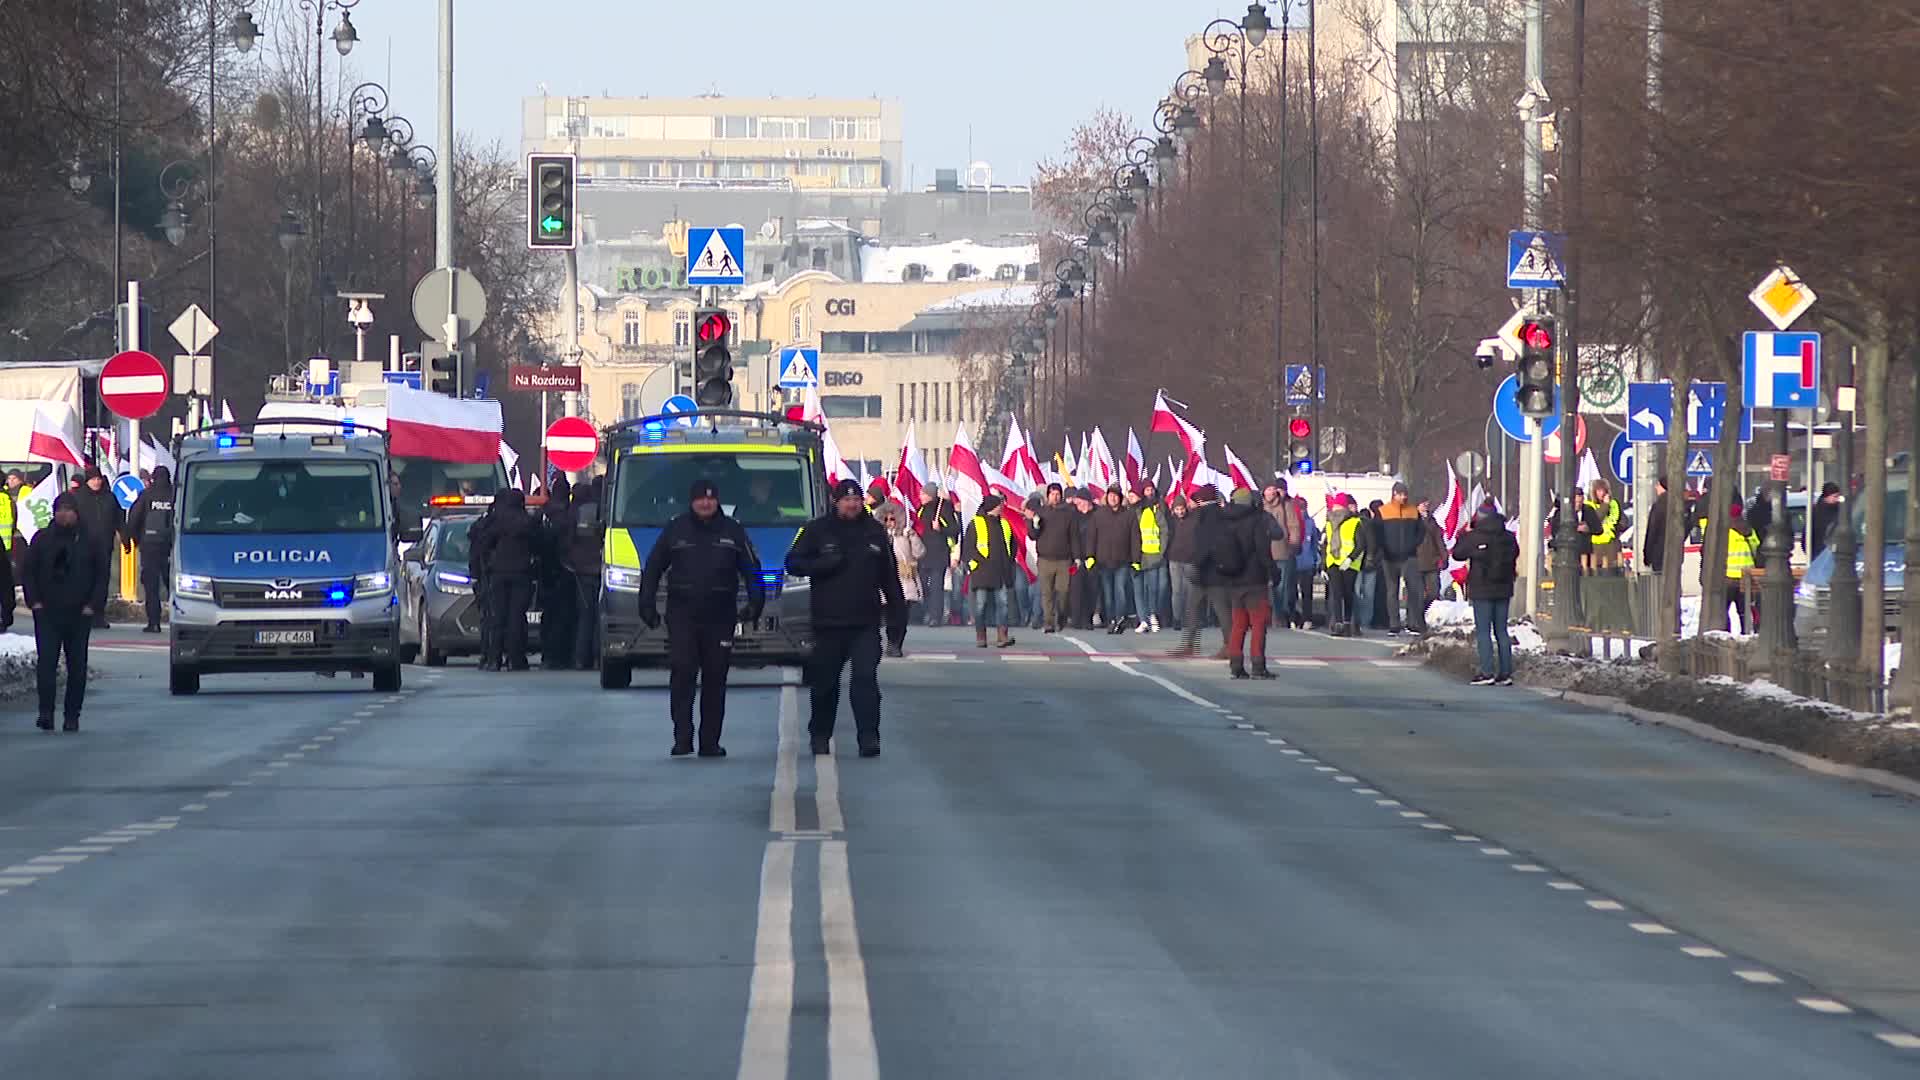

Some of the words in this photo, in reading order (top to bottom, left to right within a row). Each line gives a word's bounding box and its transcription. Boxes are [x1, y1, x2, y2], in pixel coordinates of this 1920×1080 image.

[825, 298, 855, 316] CGI
[515, 374, 529, 386] Na
[531, 373, 576, 386] Rozdrożu
[824, 370, 863, 387] ERGO
[233, 549, 331, 564] POLICJA
[264, 590, 302, 600] MAN
